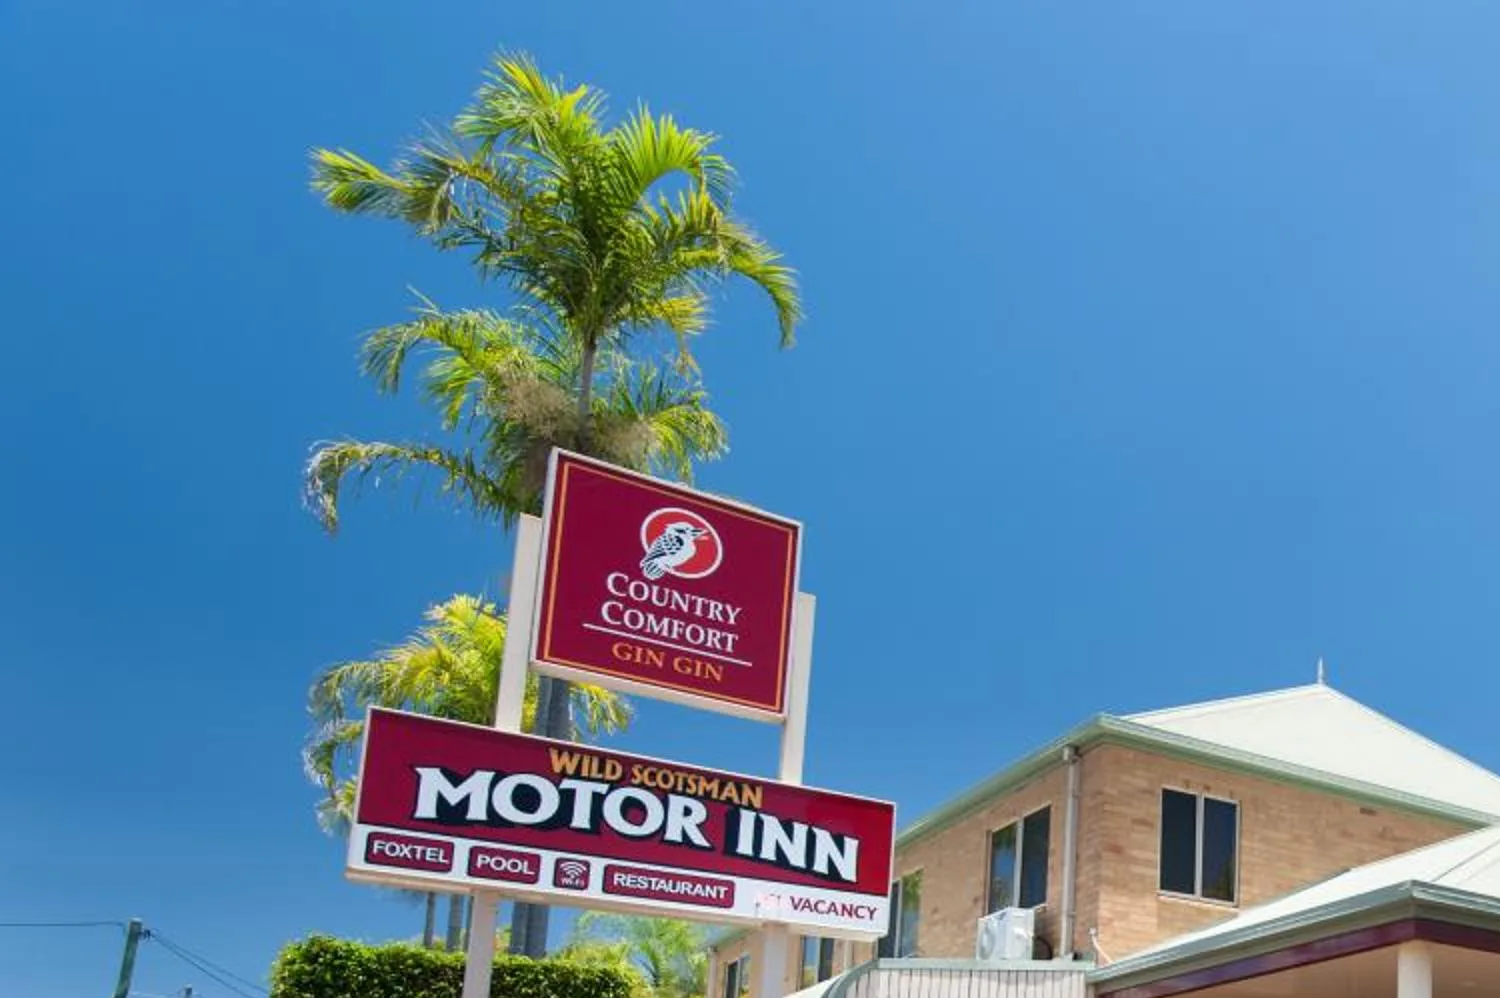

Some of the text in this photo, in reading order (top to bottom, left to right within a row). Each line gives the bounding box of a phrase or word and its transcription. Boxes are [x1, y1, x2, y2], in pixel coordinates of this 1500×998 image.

[606, 572, 742, 625] COUNTRY
[601, 601, 739, 653] COMFORT
[611, 642, 724, 682] GIN GIN
[549, 748, 763, 808] WILD SCOTSMAN
[413, 766, 859, 883] MOTOR INN
[372, 839, 449, 864] FOXTEL
[476, 853, 536, 876] POOL
[613, 872, 729, 899] RESTAURANT
[789, 895, 878, 920] VACANCY
